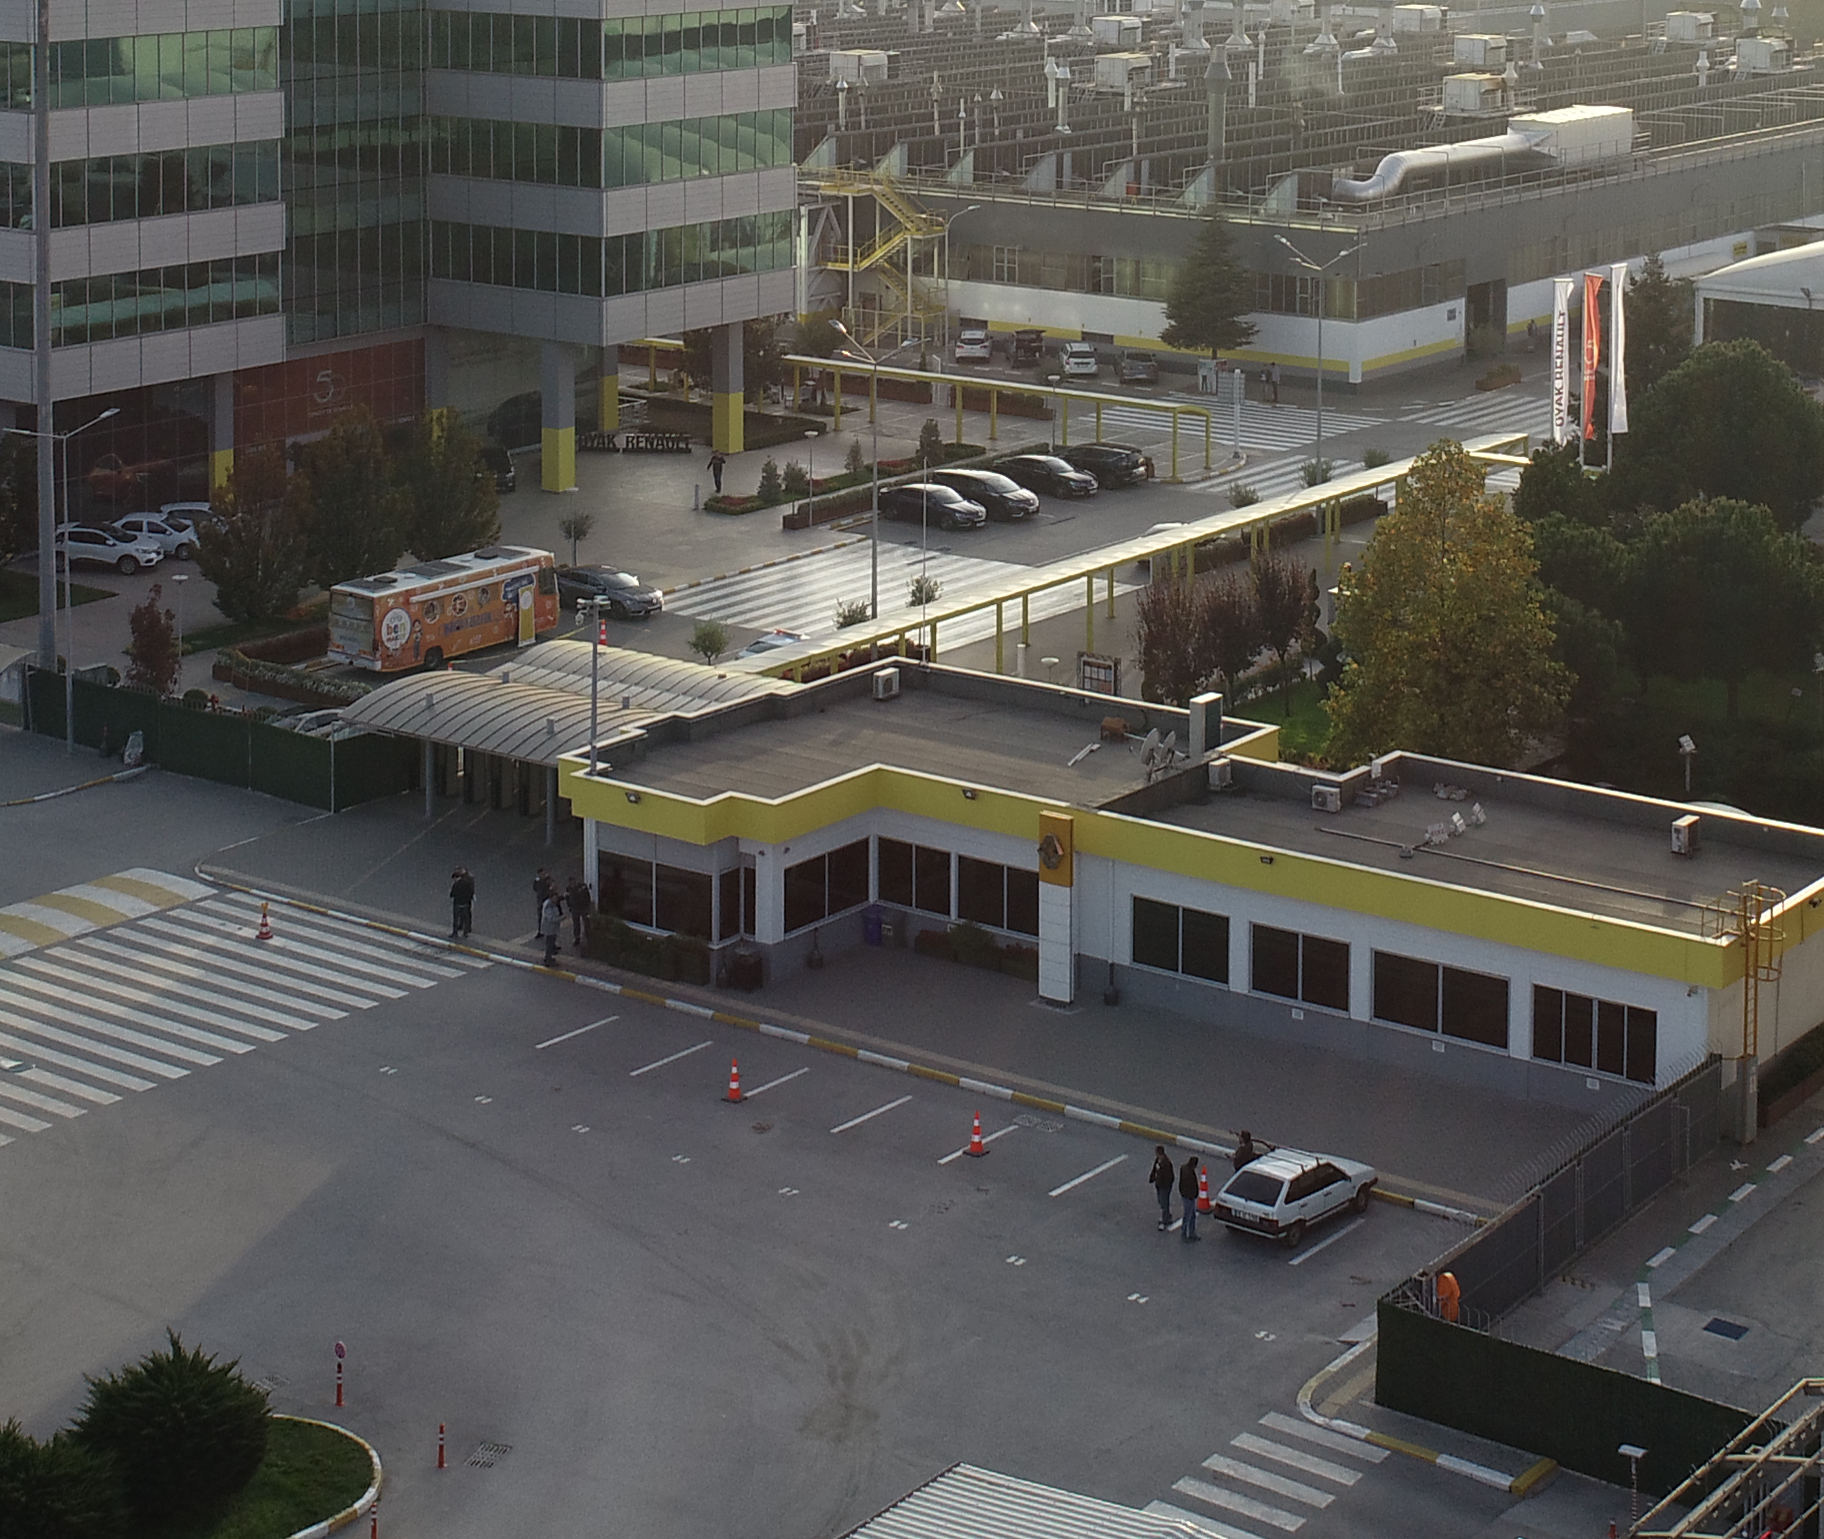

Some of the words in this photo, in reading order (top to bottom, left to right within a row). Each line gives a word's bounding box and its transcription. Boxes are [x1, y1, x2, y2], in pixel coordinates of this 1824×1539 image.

[1555, 310, 1566, 381] RENAULT
[1555, 386, 1565, 427] OYAK
[626, 433, 692, 451] RENAULT
